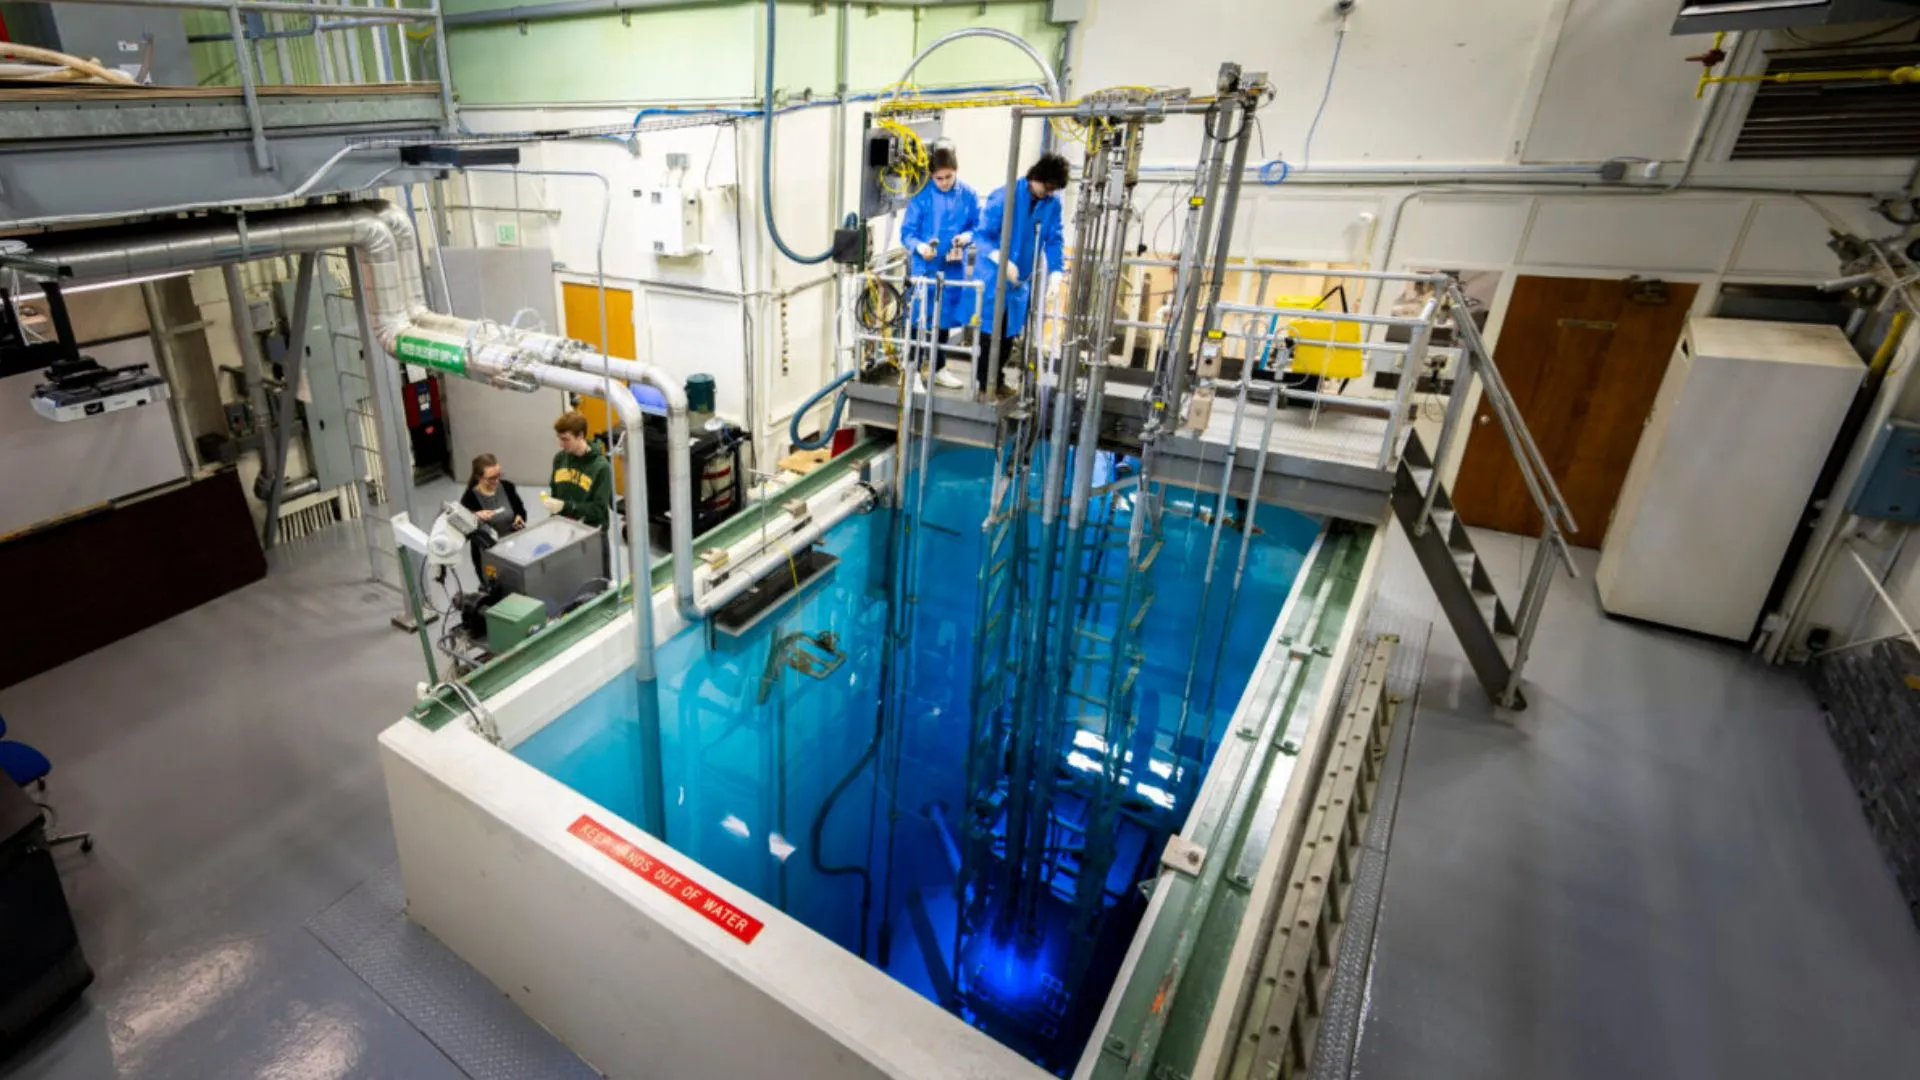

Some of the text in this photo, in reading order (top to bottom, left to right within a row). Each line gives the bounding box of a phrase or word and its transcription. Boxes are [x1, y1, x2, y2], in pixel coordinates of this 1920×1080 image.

[654, 868, 682, 889] OUT
[681, 885, 703, 901] OF
[703, 898, 749, 932] WATER
